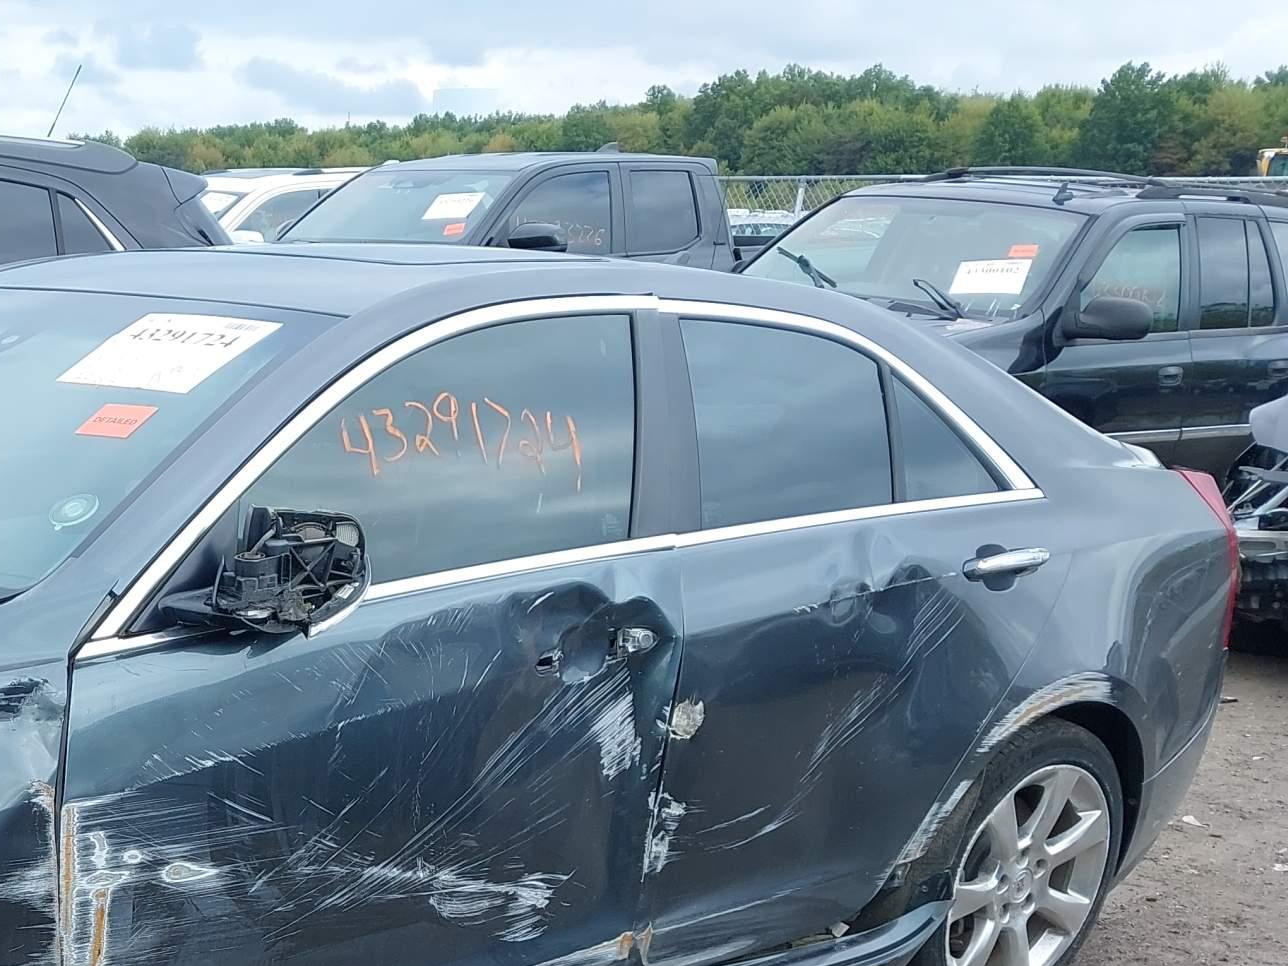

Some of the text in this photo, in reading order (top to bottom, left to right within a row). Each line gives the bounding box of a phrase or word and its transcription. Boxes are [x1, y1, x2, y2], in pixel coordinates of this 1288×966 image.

[128, 328, 242, 349] 43291724
[91, 416, 138, 425] DETAILED
[340, 391, 583, 492] 43291724
